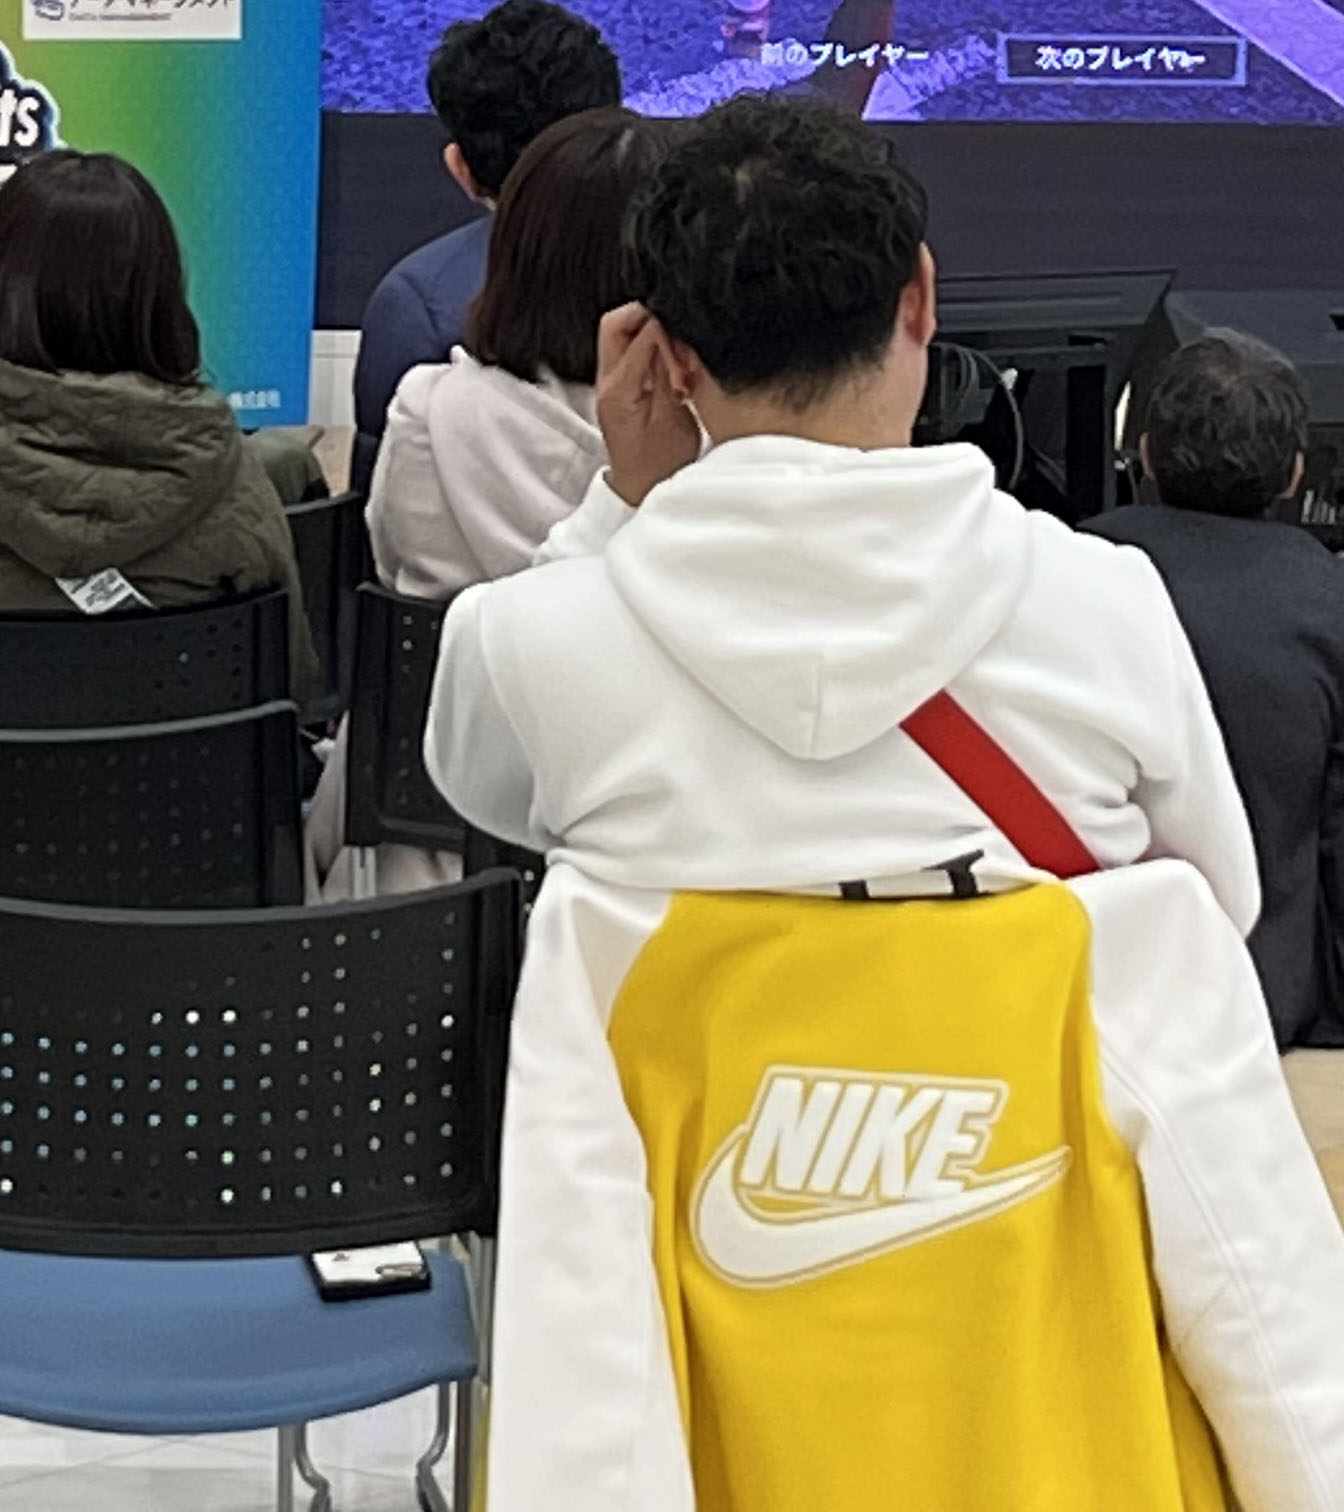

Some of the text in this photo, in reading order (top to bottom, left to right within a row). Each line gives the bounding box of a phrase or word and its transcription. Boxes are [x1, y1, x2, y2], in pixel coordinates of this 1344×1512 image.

[1036, 44, 1206, 72] 次のプレイヤー
[740, 1076, 997, 1199] NIKE
